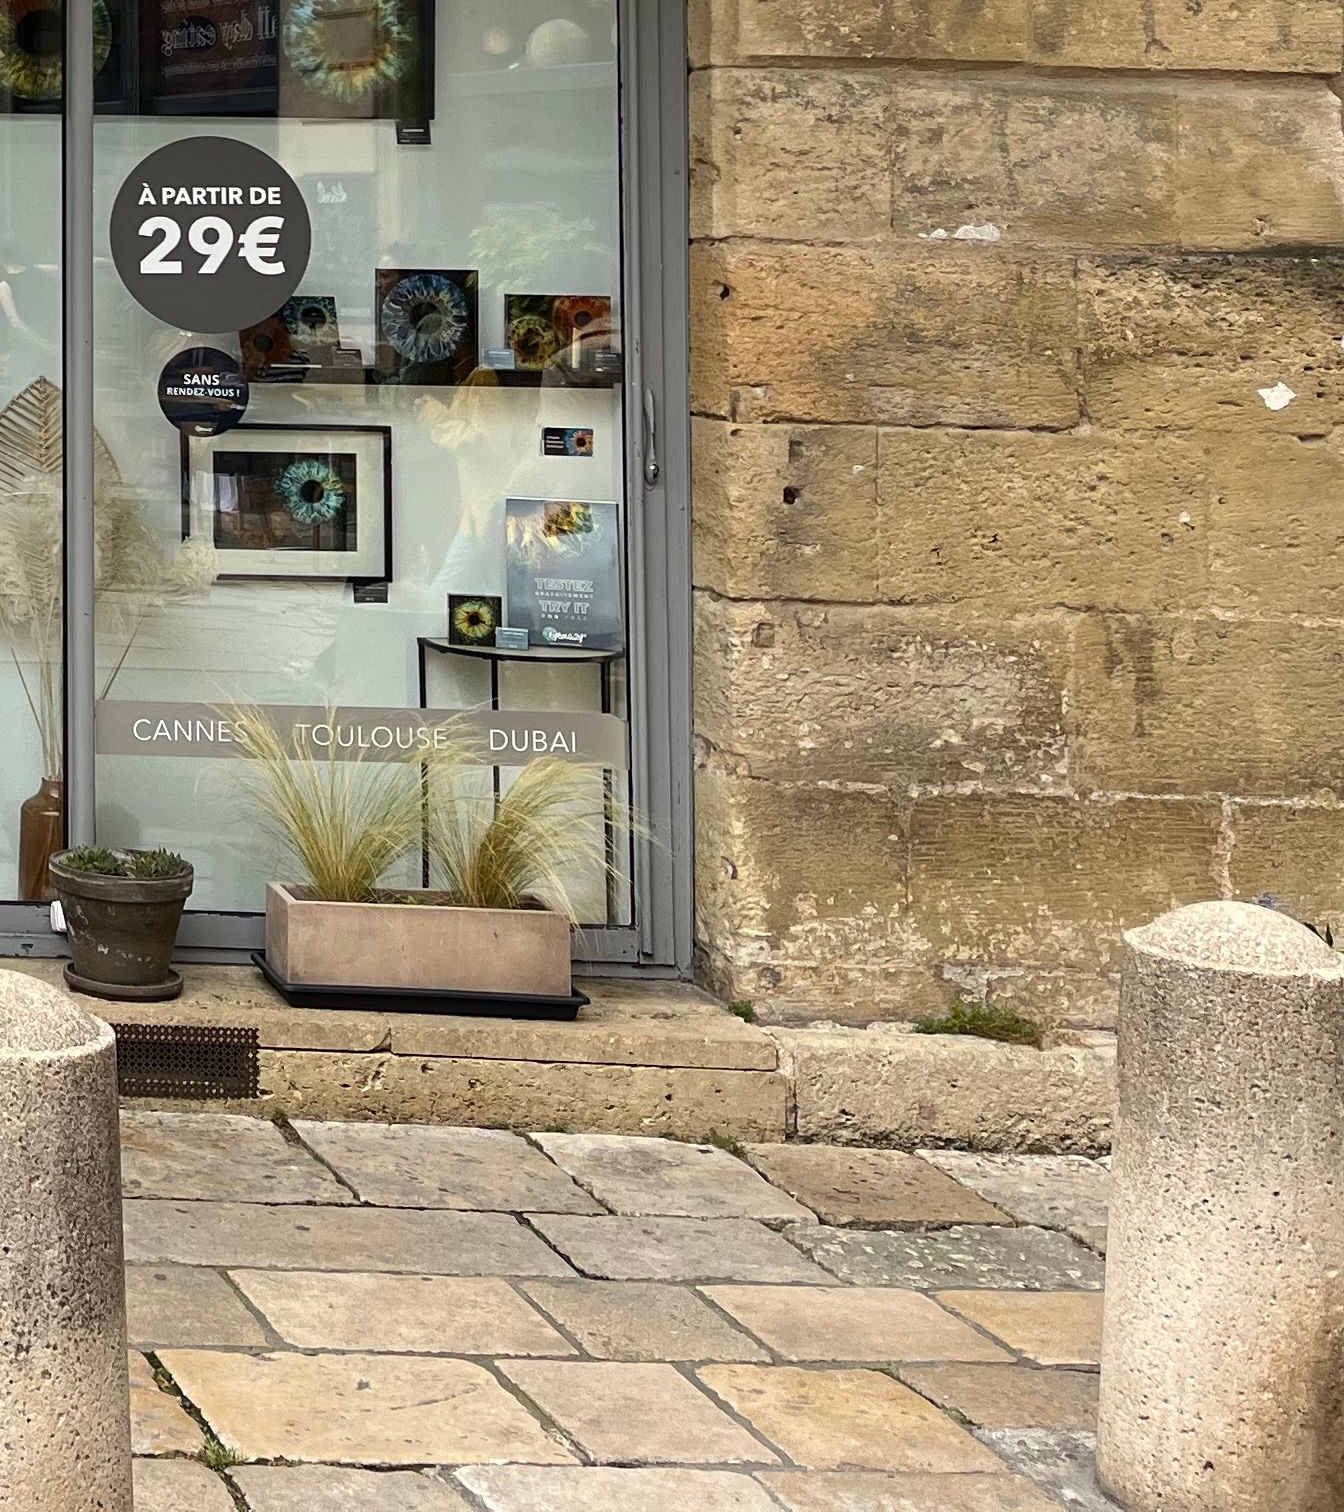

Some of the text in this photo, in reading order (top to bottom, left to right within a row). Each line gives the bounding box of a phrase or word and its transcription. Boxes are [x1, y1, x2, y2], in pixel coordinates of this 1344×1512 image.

[138, 182, 282, 206] À PARTIR DE
[137, 215, 287, 276] 29€
[183, 373, 220, 386] SANS
[166, 387, 233, 397] RENDEZ-VOUS
[534, 577, 594, 593] TESTEZ
[538, 599, 590, 615] TRY IT
[131, 717, 578, 754] CANNES TOULOUSE DUBAI
